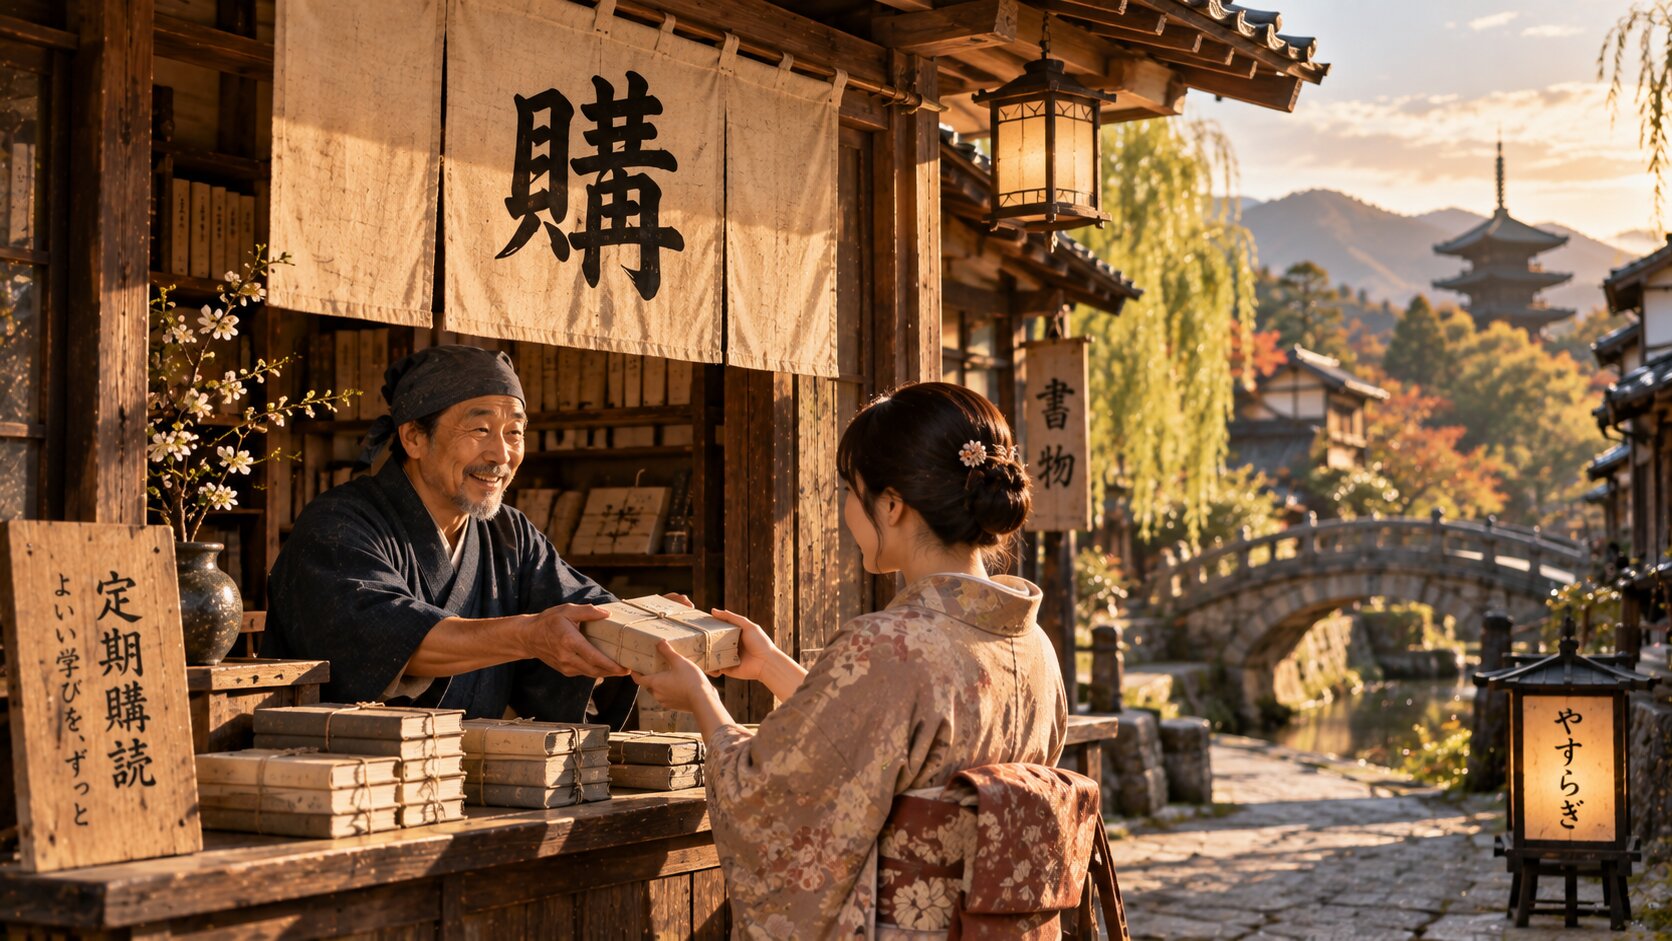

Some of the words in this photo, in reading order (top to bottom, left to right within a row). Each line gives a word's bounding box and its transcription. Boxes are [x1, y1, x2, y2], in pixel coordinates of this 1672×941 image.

[495, 70, 685, 301] 購
[1036, 378, 1075, 489] 書物
[97, 571, 156, 789] 定期購読
[1554, 708, 1584, 830] やすらぎ
